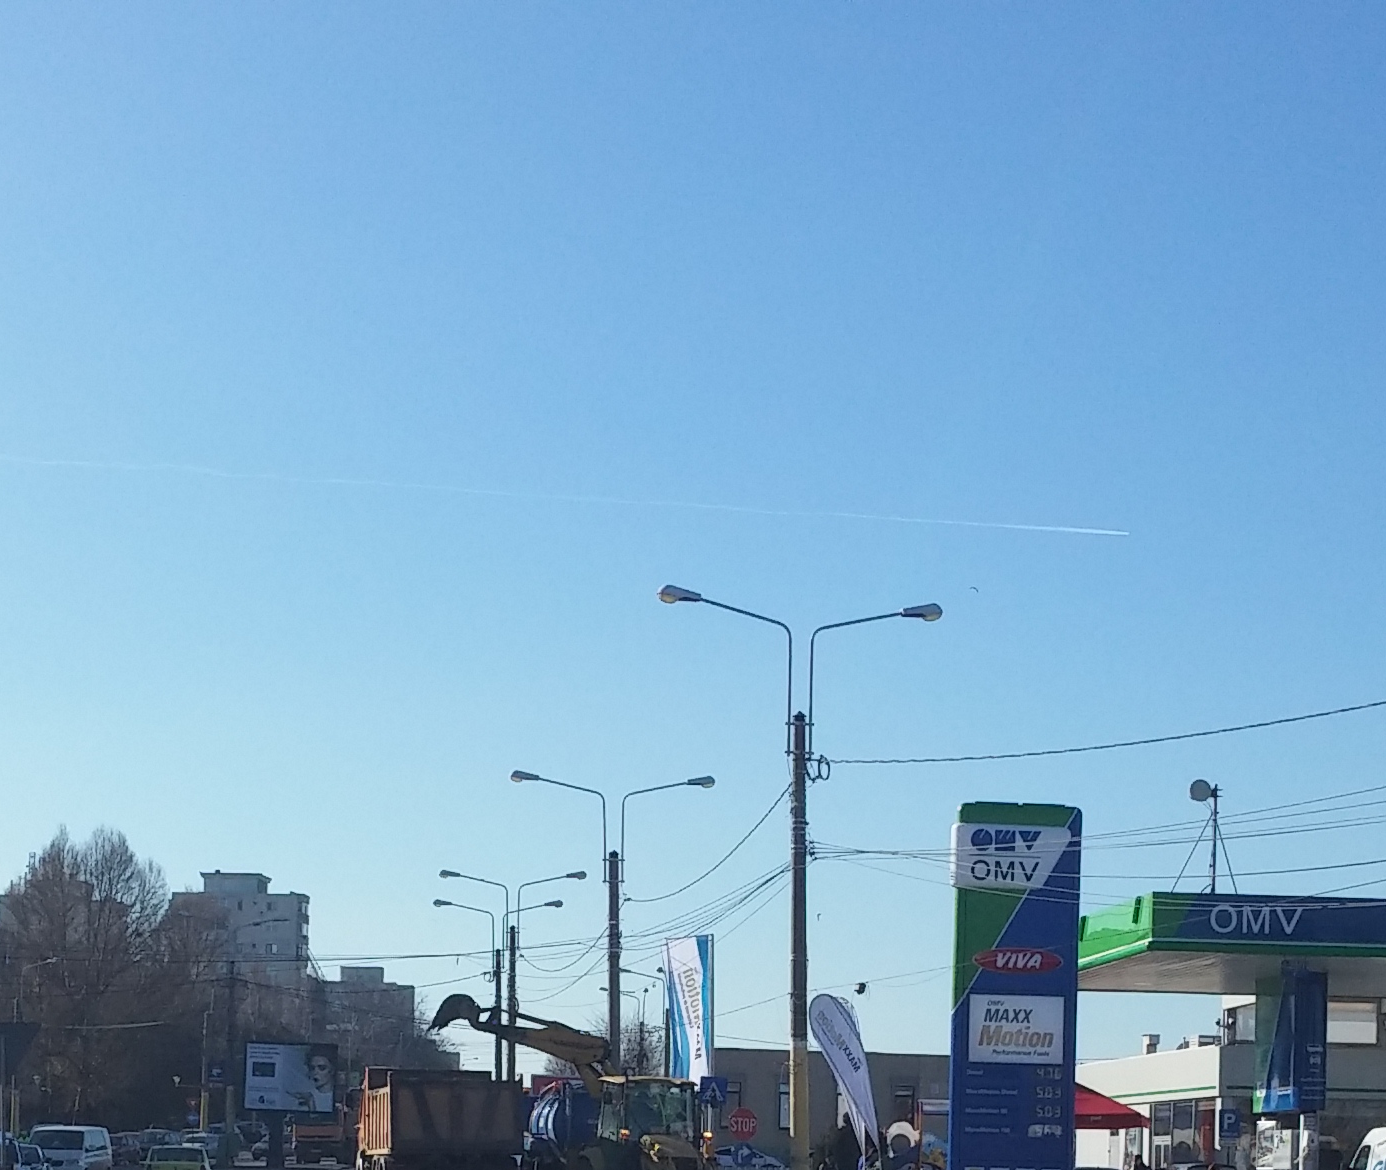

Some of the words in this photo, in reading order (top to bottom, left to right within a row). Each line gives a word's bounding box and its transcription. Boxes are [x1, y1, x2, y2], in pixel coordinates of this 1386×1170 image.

[970, 859, 1040, 882] OMV
[1210, 904, 1303, 935] OMV
[995, 951, 1043, 970] VIVA
[983, 1008, 1033, 1024] MAXX
[978, 1024, 1054, 1048] Motion
[730, 1117, 757, 1132] STOP
[1223, 1113, 1236, 1130] P
